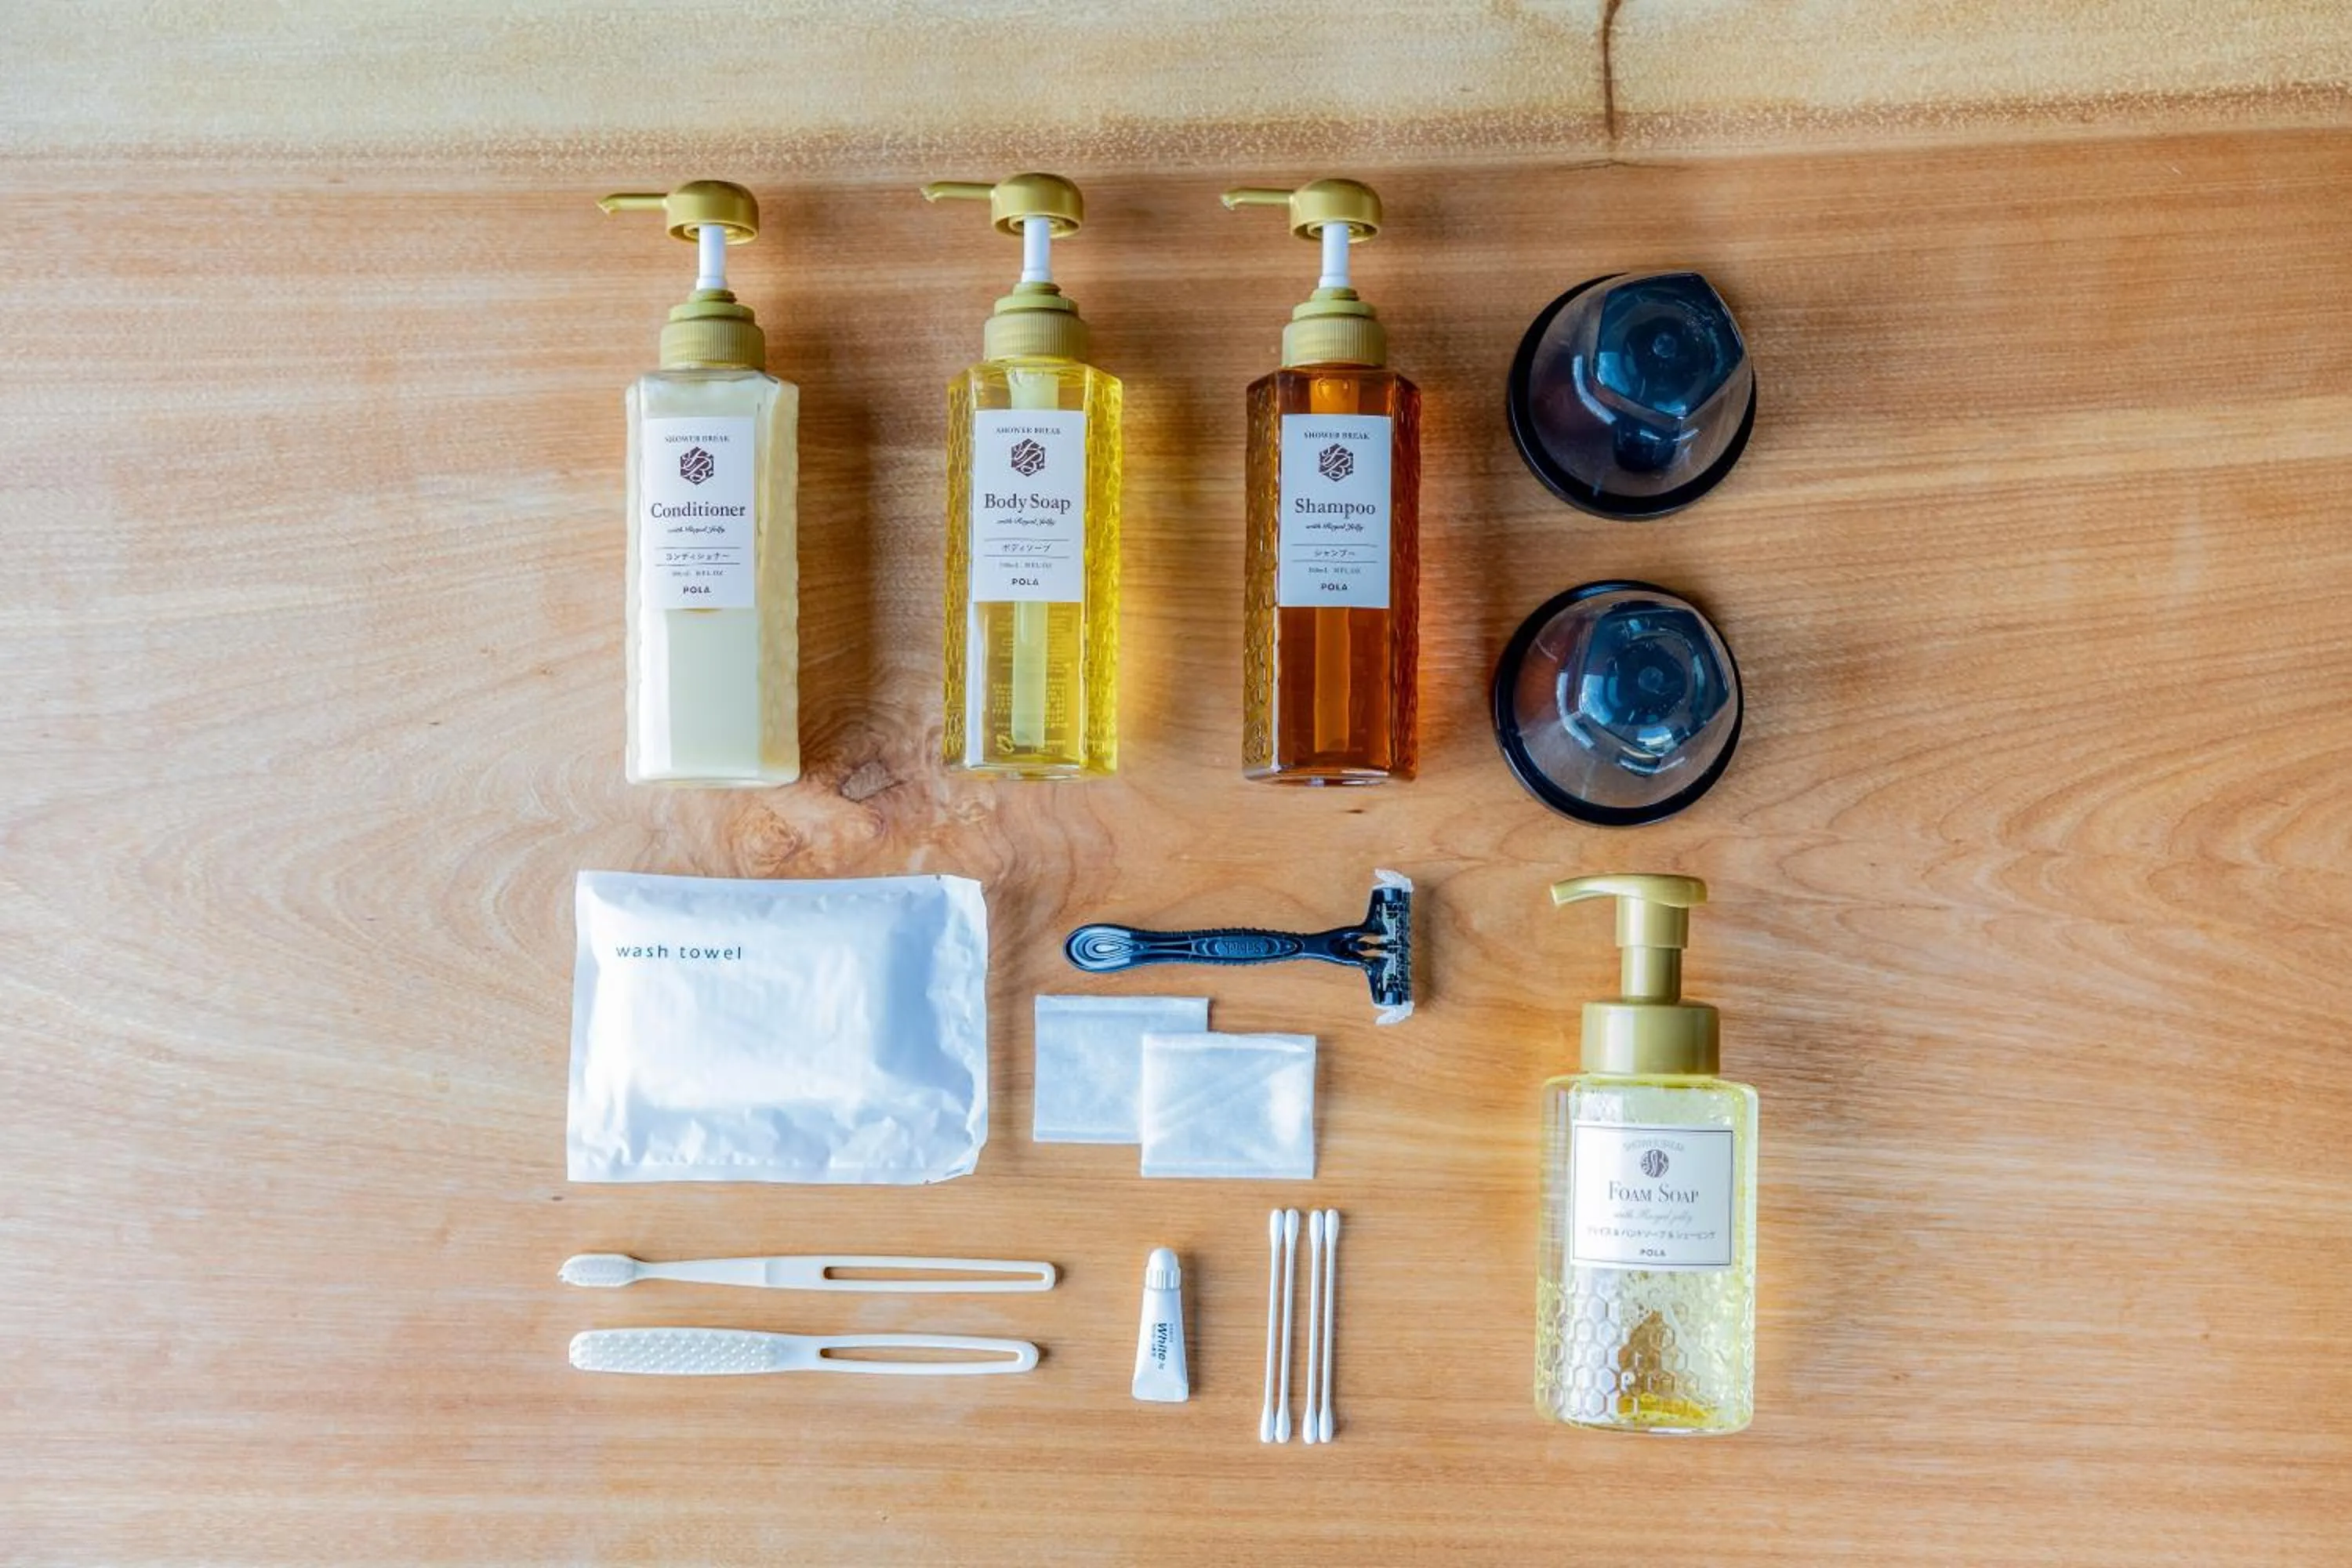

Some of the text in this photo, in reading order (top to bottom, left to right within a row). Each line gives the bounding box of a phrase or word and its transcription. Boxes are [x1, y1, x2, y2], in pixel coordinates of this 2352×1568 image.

[665, 434, 730, 443] SHOWER BREAK
[651, 502, 746, 518] Conditioner
[985, 493, 1071, 514] Body Soap
[1294, 499, 1376, 519] Shampoo
[683, 586, 711, 594] POLA
[1320, 583, 1348, 591] POLA
[615, 945, 742, 960] wash towel
[1609, 1181, 1699, 1203] FOAM SOAP
[1639, 1248, 1666, 1258] POLA
